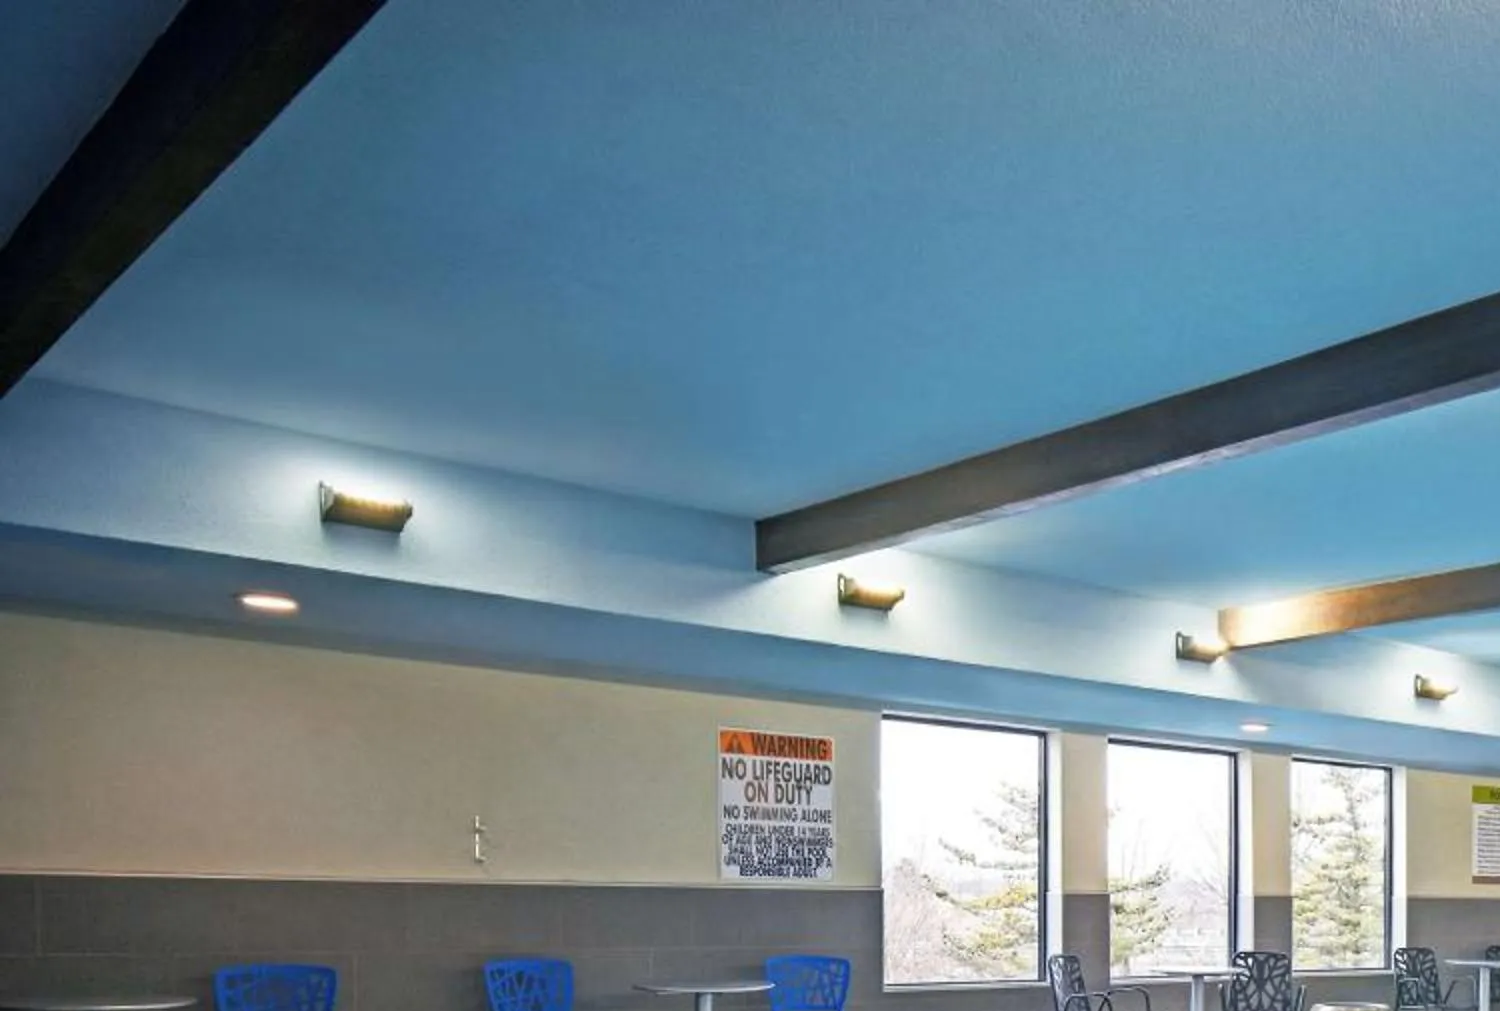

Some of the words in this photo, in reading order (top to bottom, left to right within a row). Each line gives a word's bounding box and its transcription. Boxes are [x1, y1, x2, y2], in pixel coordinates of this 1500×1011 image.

[752, 732, 828, 760] WARNING
[721, 758, 747, 780] NO
[752, 761, 833, 785] LIFEGUARD
[744, 781, 769, 803] ON
[775, 783, 814, 806] DUTY
[723, 805, 741, 820] NO
[743, 805, 798, 822] SWIMMING
[800, 808, 833, 824] ALONE
